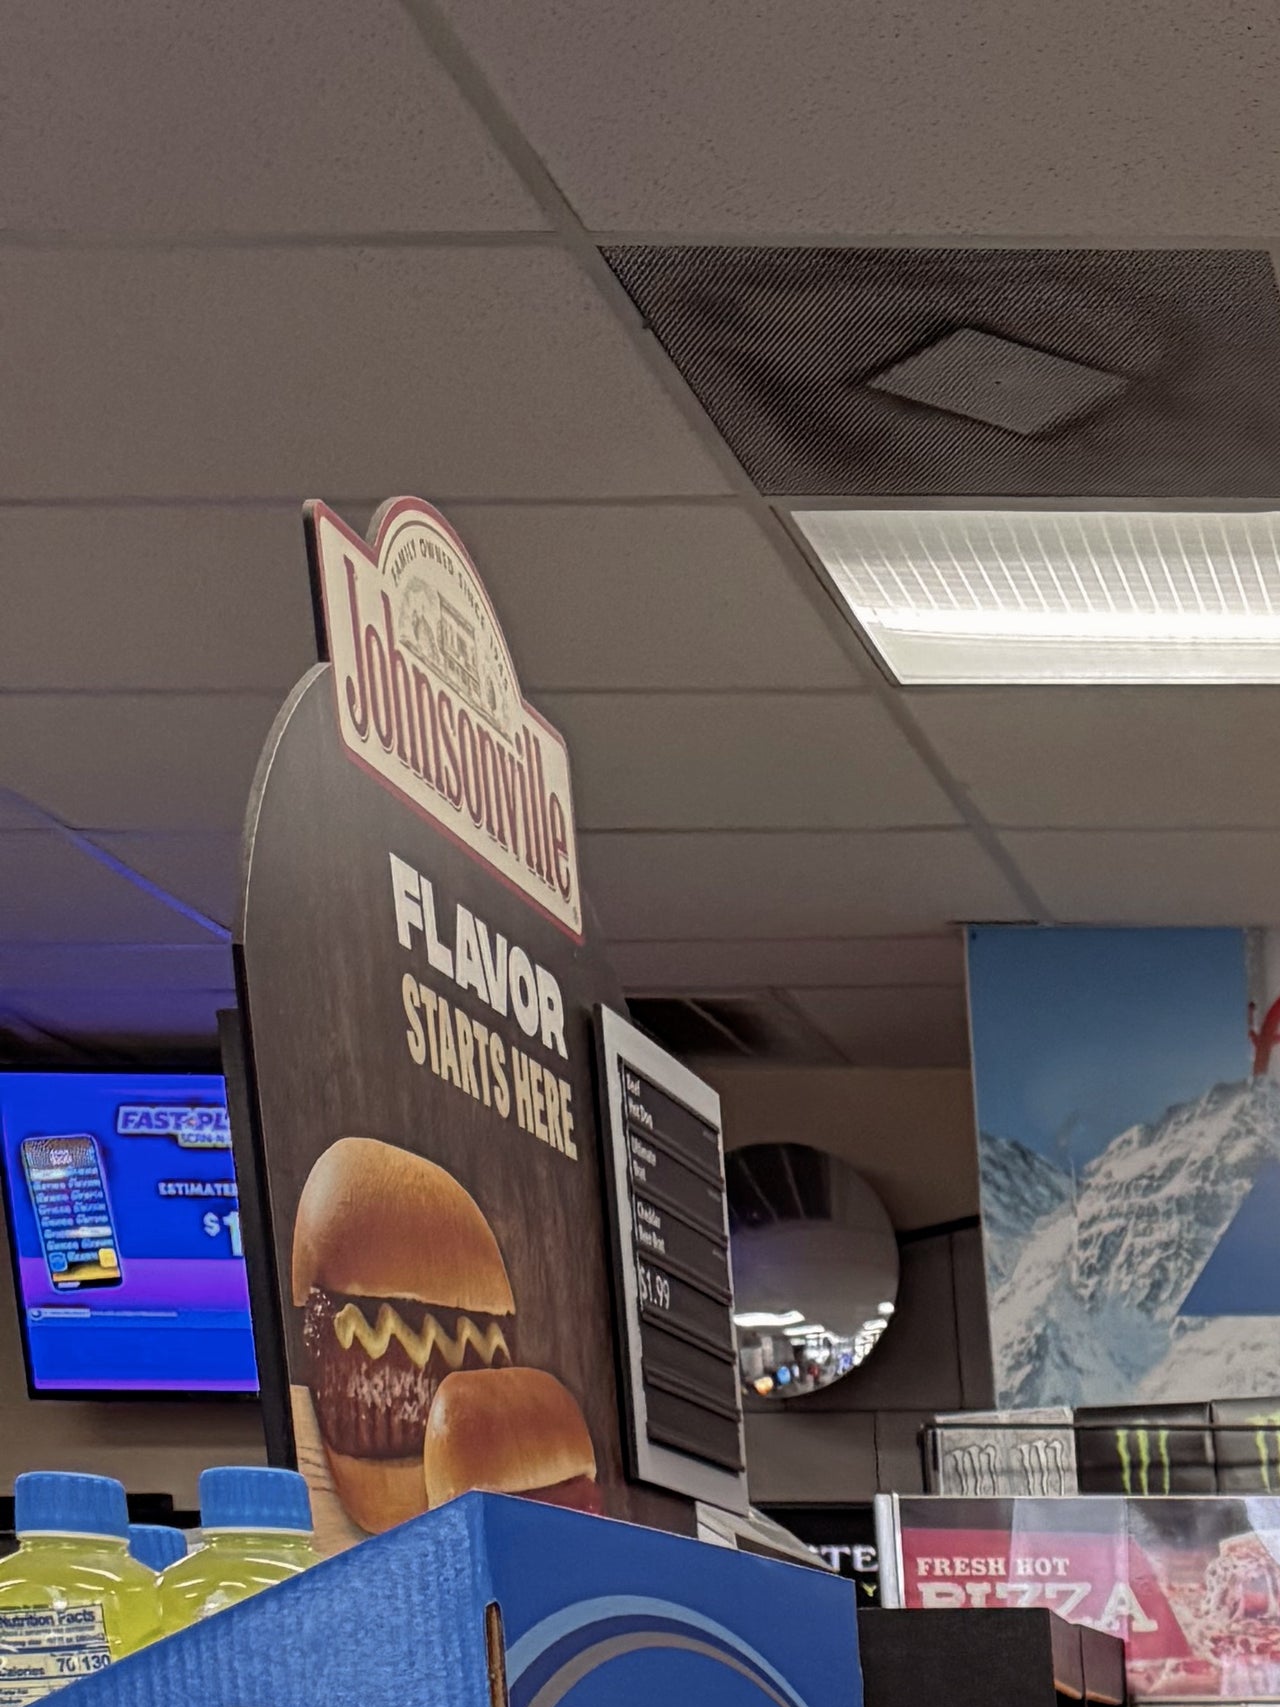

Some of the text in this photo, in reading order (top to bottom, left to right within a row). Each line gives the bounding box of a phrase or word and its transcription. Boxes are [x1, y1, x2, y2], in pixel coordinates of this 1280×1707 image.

[344, 554, 571, 898] Johnsonville
[389, 853, 568, 1059] FLAVOR
[402, 973, 579, 1161] STARTS HERE
[121, 1110, 182, 1131] FAST
[916, 1556, 1070, 1578] FRESH HOT
[57, 1608, 96, 1625] Facts
[56, 1653, 111, 1673] 70 130
